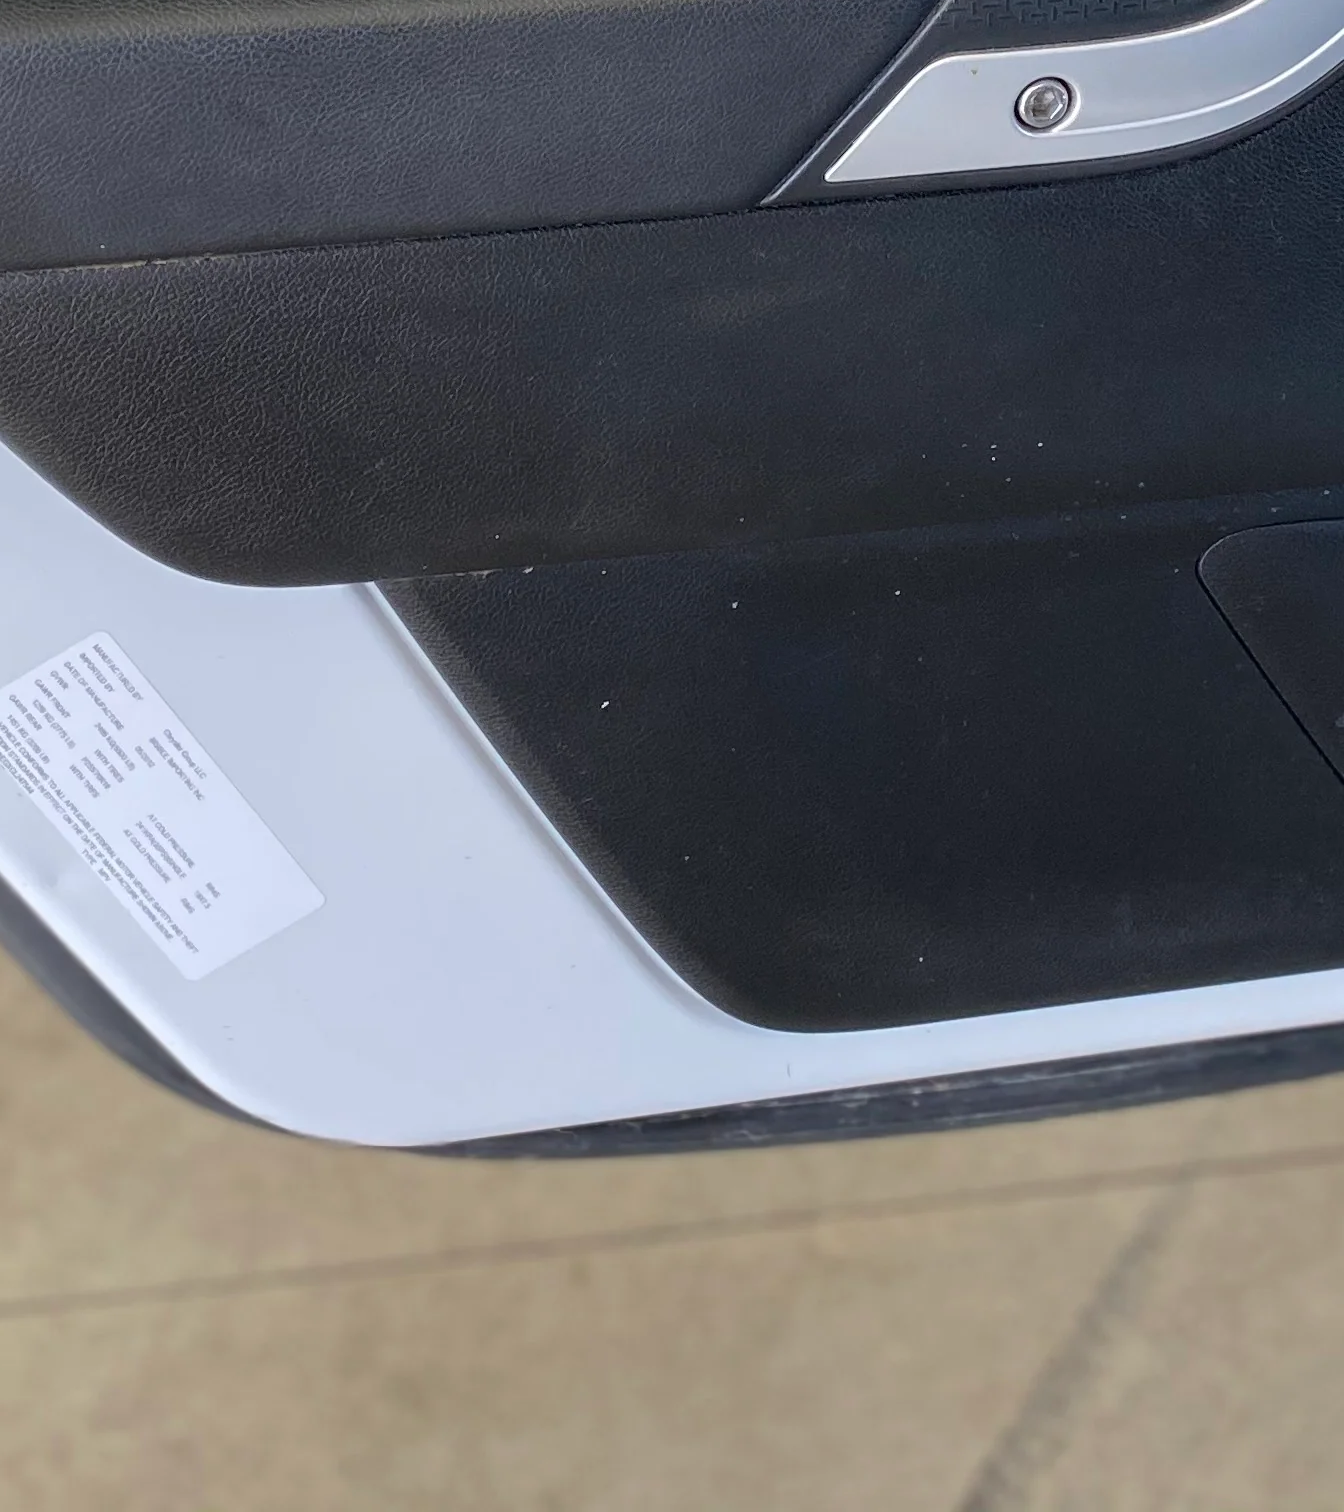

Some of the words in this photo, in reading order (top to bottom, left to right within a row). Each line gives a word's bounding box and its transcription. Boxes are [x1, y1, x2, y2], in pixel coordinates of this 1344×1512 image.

[62, 660, 82, 679] DATE
[76, 676, 89, 688] OF
[83, 685, 125, 731] MANUFACTURE
[77, 651, 108, 685] IMPORTED
[102, 681, 116, 694] BY
[91, 642, 137, 694] MANUFACTURED
[130, 690, 144, 703] BY
[192, 765, 208, 780] LLC
[6, 749, 41, 787] STANDARDS
[36, 784, 48, 794] IN
[42, 791, 66, 815] EFFECT
[61, 812, 74, 825] ON
[70, 822, 84, 836] THE
[79, 833, 97, 851] DATE
[92, 848, 105, 860] OF
[100, 858, 140, 901] MANUFACTURE
[17, 745, 51, 781] CONFORMS
[45, 778, 59, 790] TO
[53, 787, 67, 800] ALL
[62, 798, 96, 834] APPLICABLE
[91, 831, 117, 859] FEDERAL
[112, 856, 136, 880] MOTOR
[130, 877, 156, 904] VEHICLE
[23, 711, 43, 732] REAR
[67, 763, 86, 782] WITH
[80, 779, 101, 799] TIRES
[121, 827, 133, 838] AT
[128, 835, 147, 855] COLD
[141, 851, 172, 884] PRESSURE
[48, 696, 72, 720] FRONT
[92, 747, 111, 766] WITH
[105, 763, 126, 784] TIRES
[146, 812, 158, 823] AT
[152, 820, 172, 840] COLD
[166, 836, 196, 869] PRESSURE
[79, 848, 98, 866] TYPE
